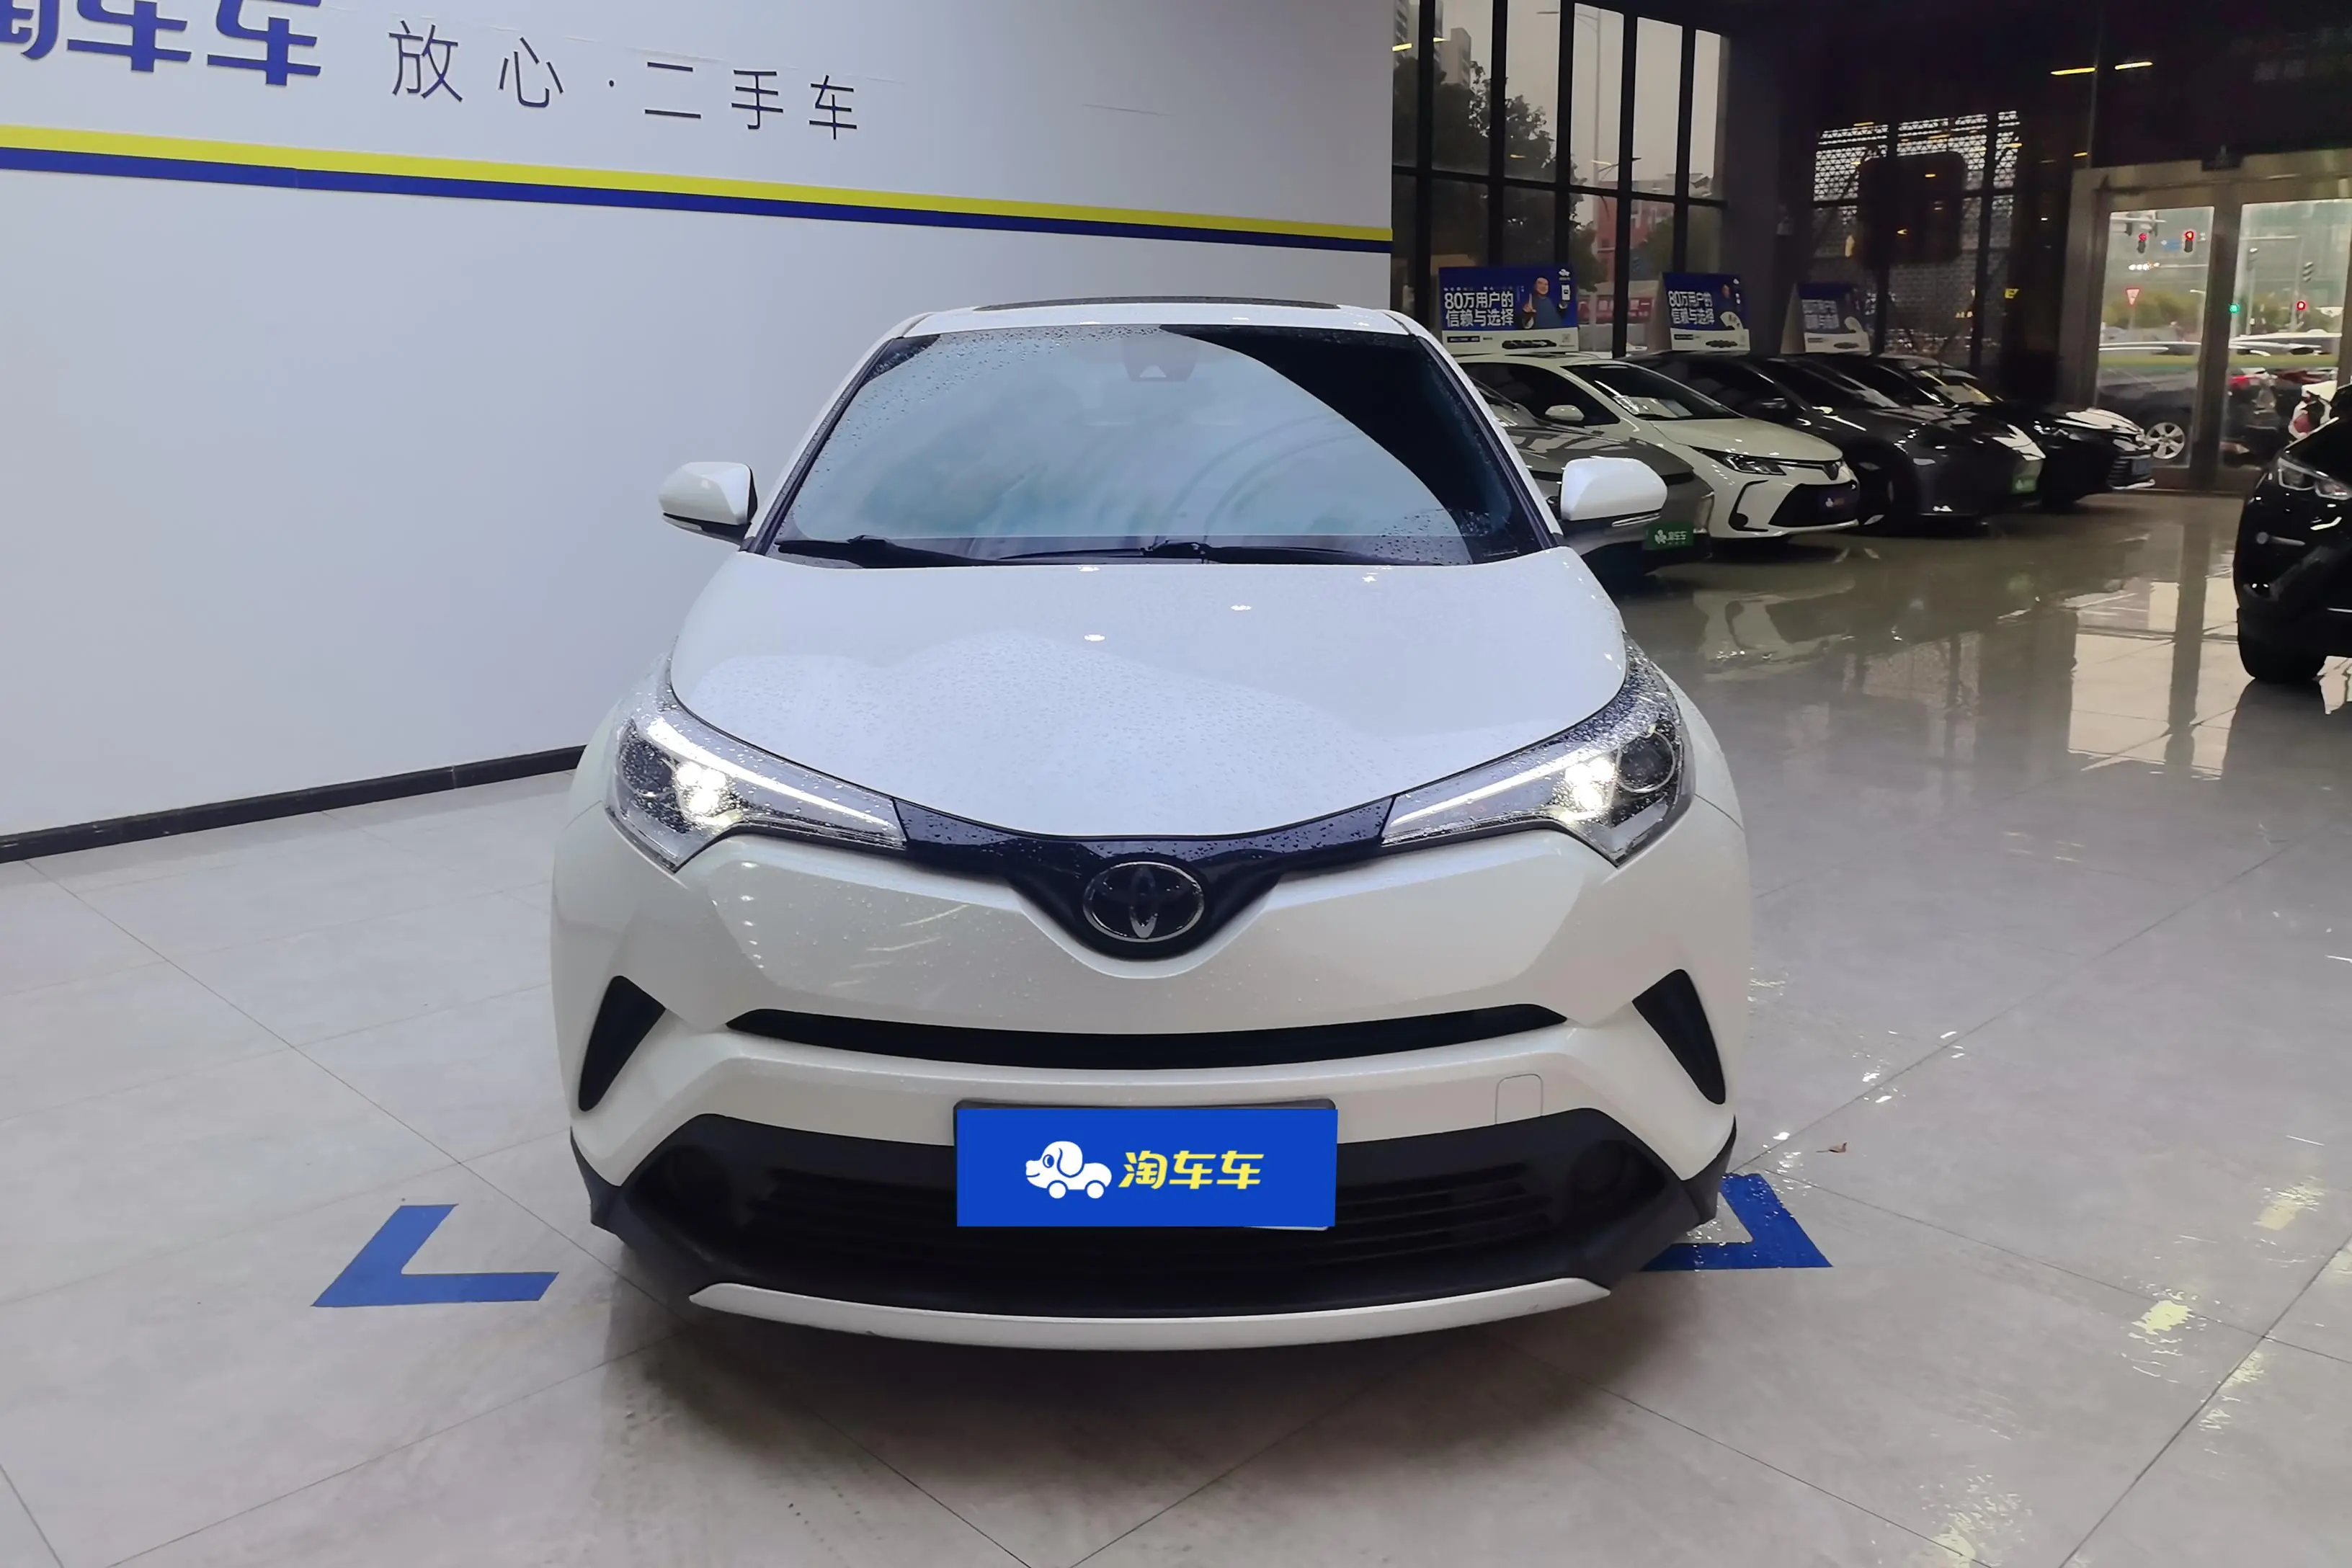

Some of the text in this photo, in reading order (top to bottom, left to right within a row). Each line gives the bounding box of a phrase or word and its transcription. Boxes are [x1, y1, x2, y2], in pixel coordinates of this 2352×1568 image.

[1444, 290, 1514, 310] 80万用户的
[1445, 308, 1514, 328] 信赖与选择
